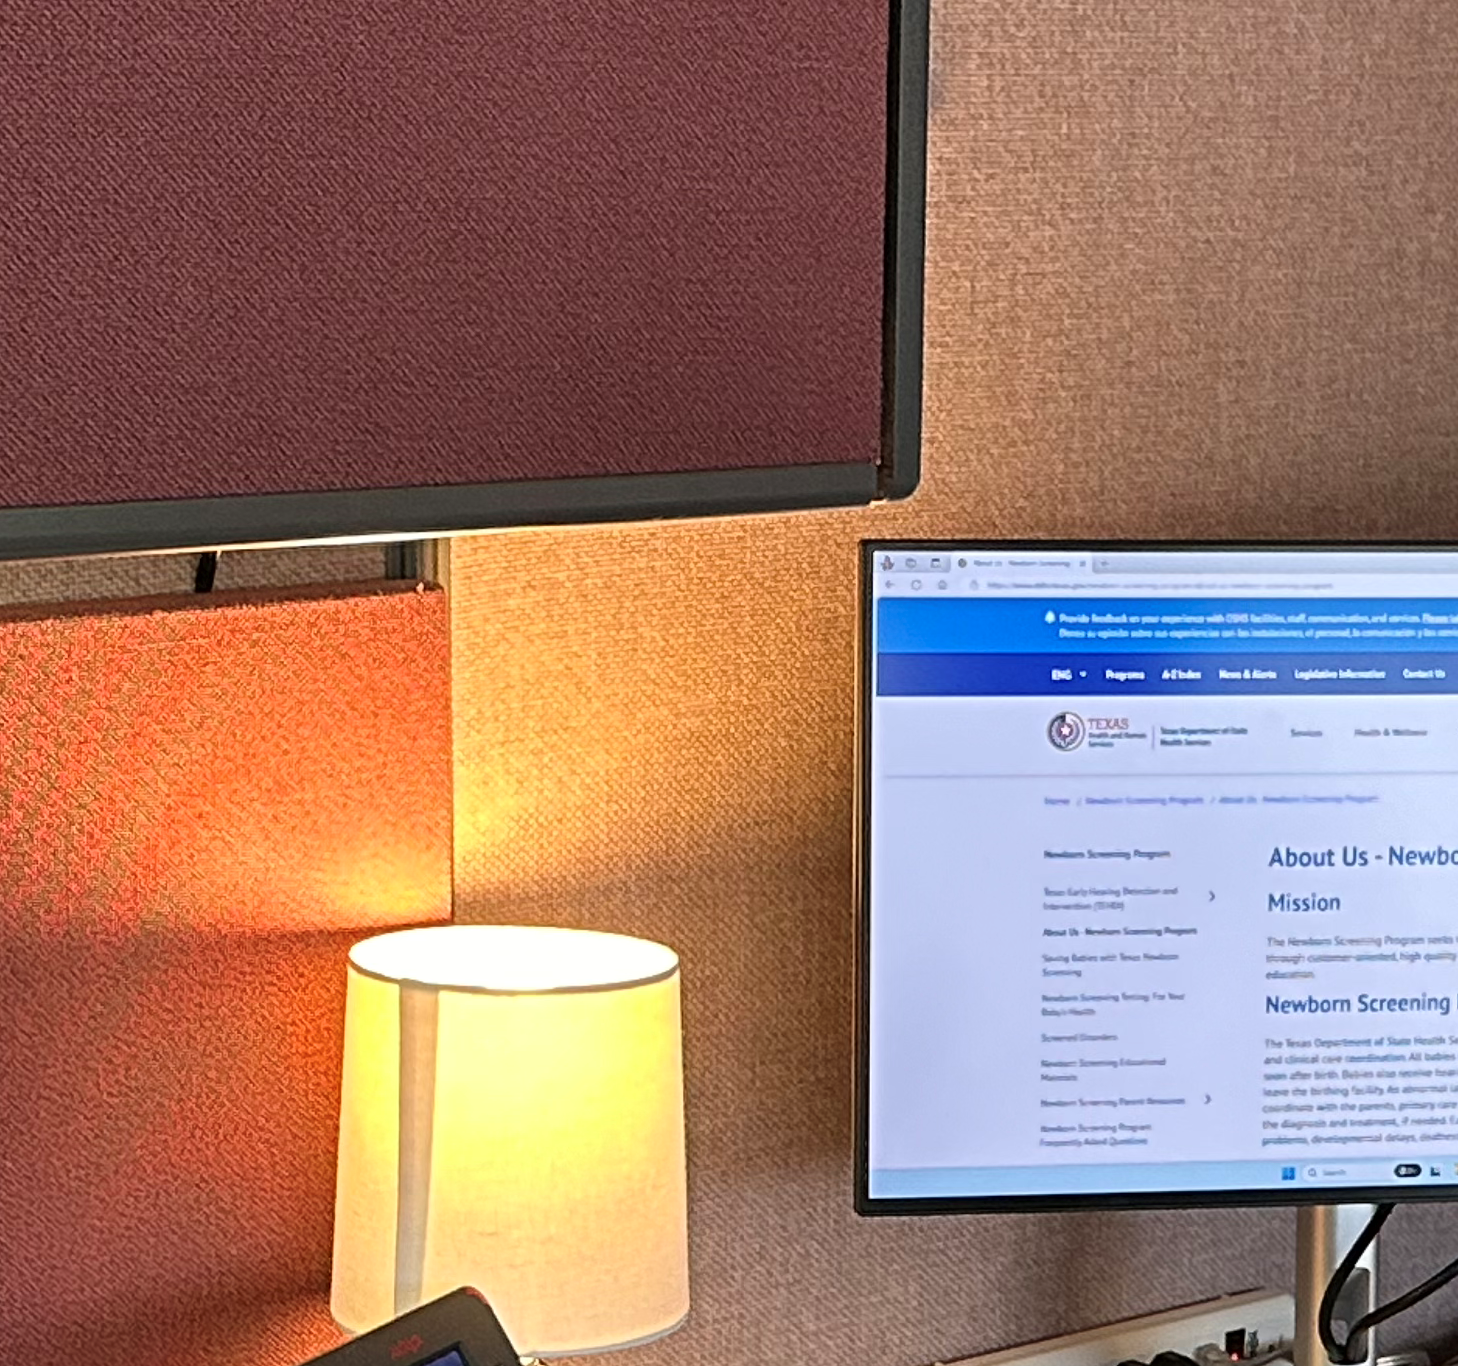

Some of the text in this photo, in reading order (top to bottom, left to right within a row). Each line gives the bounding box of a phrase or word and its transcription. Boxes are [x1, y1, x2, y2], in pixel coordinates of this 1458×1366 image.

[1051, 669, 1072, 680] ENG
[1105, 669, 1145, 682] Programs
[1088, 718, 1129, 730] TEXAS
[1268, 846, 1335, 867] About
[1342, 846, 1368, 866] Us
[1268, 893, 1340, 911] Mission
[1266, 994, 1351, 1013] Newborn
[1357, 992, 1450, 1016] Screening
